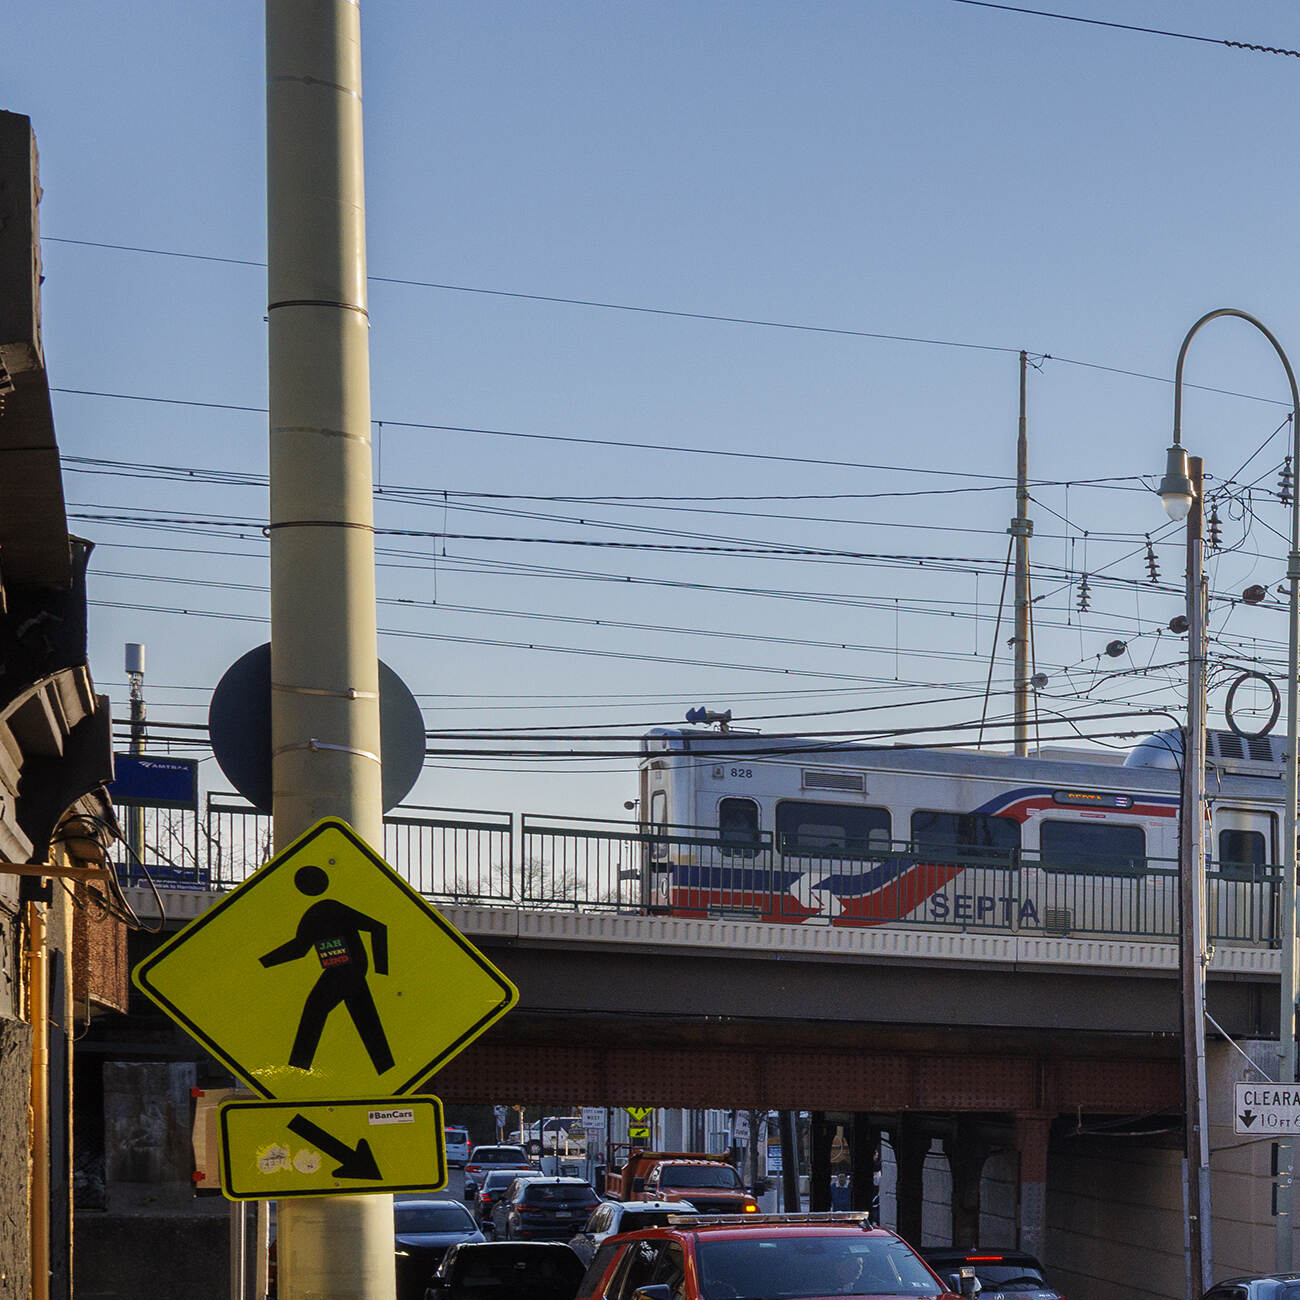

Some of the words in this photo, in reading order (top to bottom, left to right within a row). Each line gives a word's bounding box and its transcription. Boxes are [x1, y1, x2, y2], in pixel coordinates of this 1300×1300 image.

[730, 767, 753, 779] 828
[929, 892, 1041, 924] SEPTA
[369, 1111, 413, 1120] #BanCars
[1261, 1113, 1278, 1127] 10
[1279, 1119, 1291, 1127] FT
